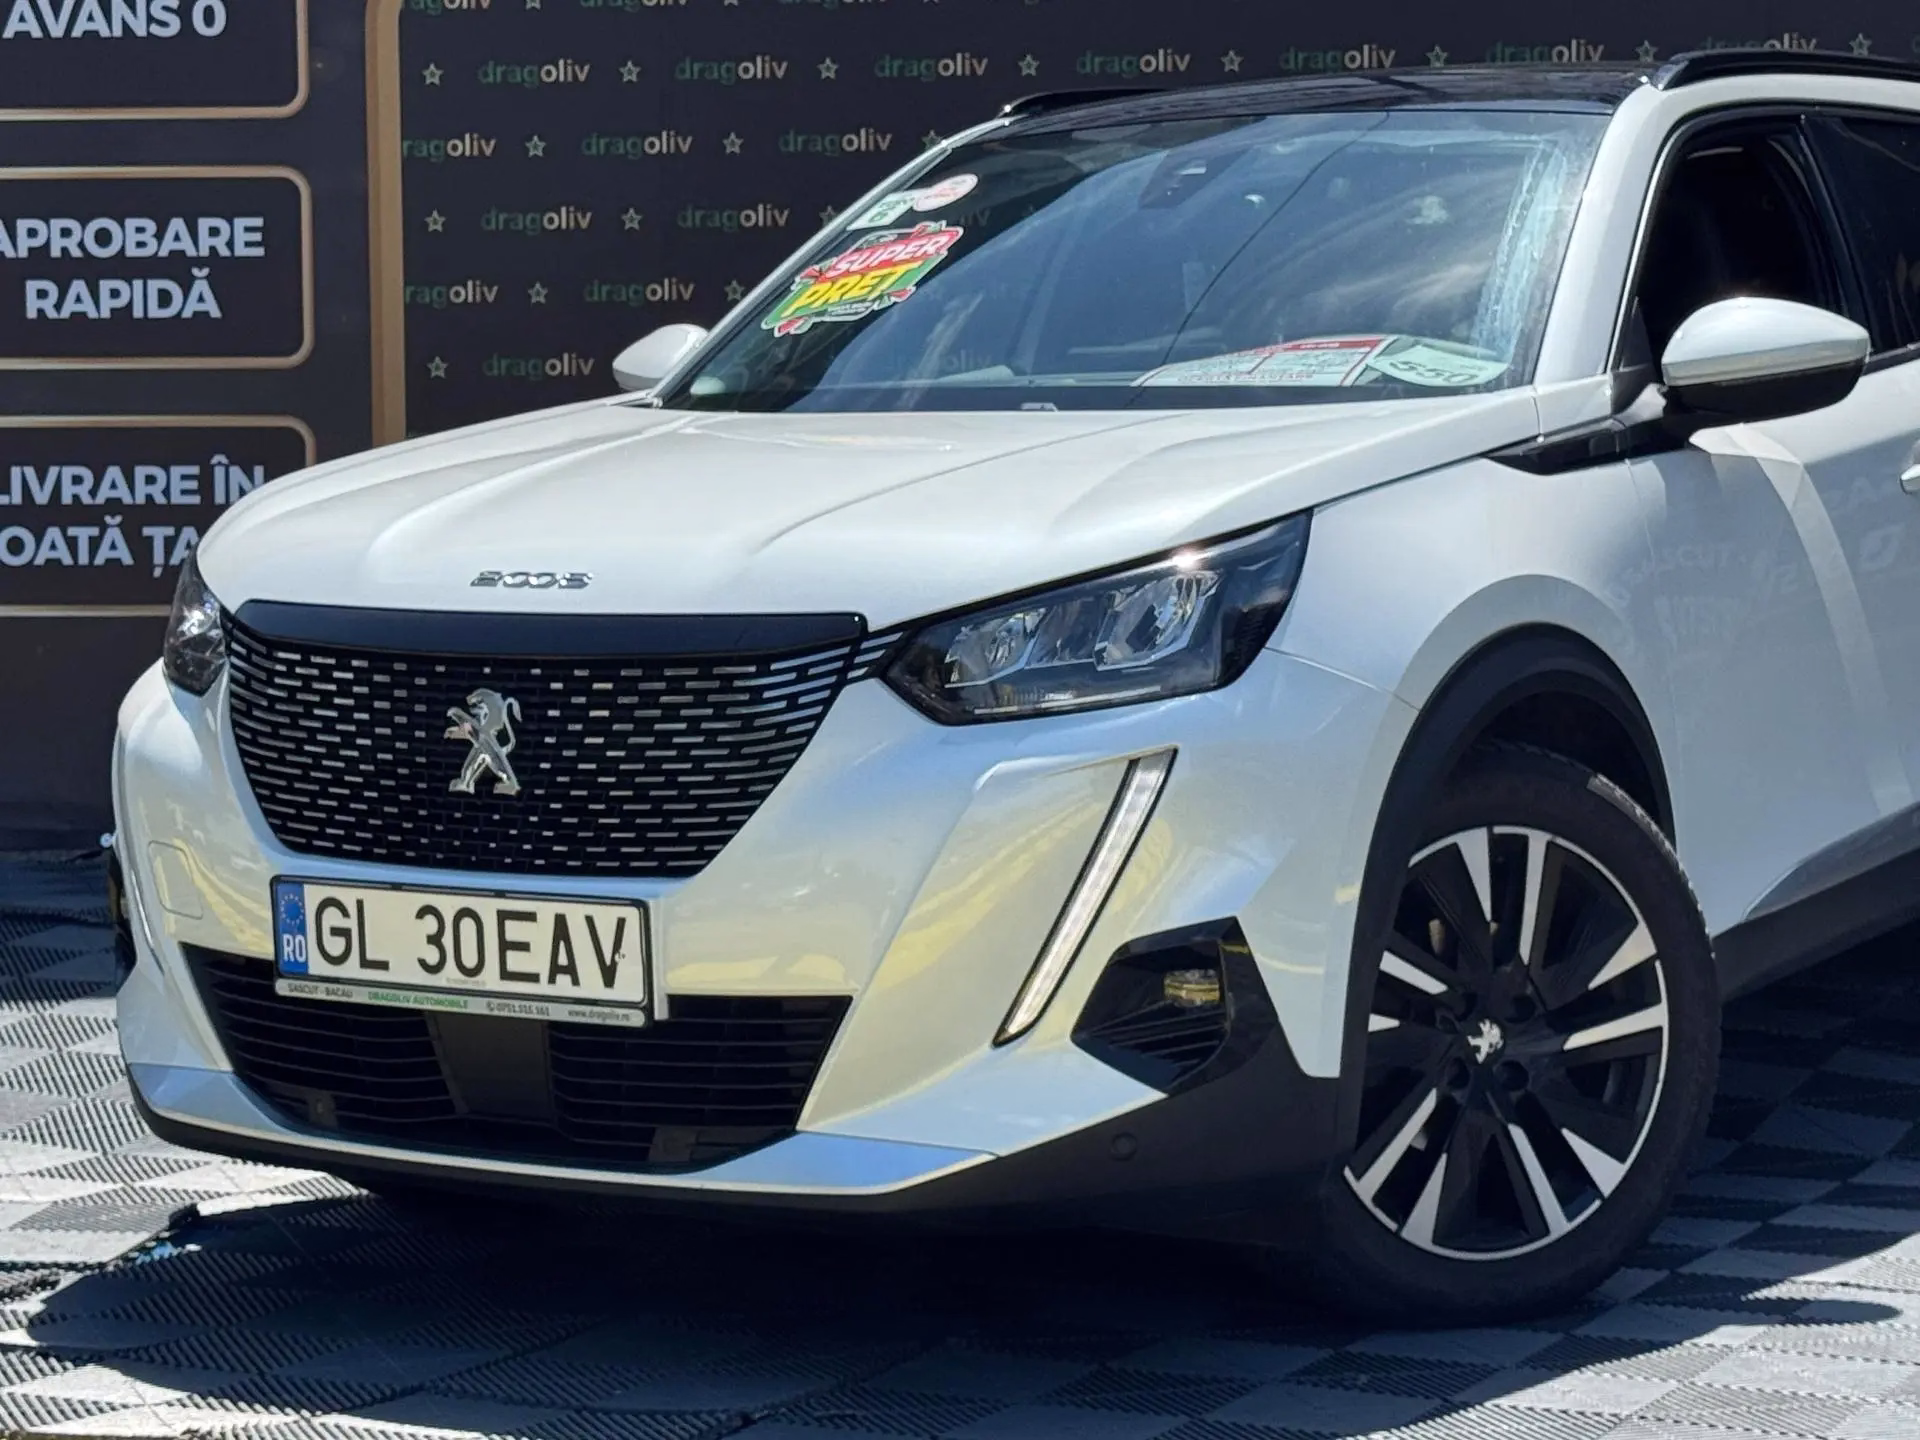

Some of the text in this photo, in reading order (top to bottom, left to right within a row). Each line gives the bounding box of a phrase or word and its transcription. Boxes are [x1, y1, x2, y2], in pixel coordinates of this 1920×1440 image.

[2, 0, 227, 39] AVANS 0
[478, 56, 591, 88] dragoliv
[674, 55, 788, 86] dragoliv
[875, 52, 989, 82] dragoliv
[1076, 47, 1191, 78] dragoliv
[1280, 45, 1395, 73] dragoliv
[581, 129, 693, 159] dragoliv
[779, 127, 893, 157] dragoliv
[480, 203, 790, 236] dragoliv dragoliv
[825, 235, 947, 279] SUPER
[25, 267, 223, 320] RAPIDĂ
[583, 277, 695, 307] dragoliv
[482, 350, 595, 381] dragoliv
[211, 454, 265, 504] ÎN
[282, 934, 307, 963] RO
[315, 896, 390, 972] GL
